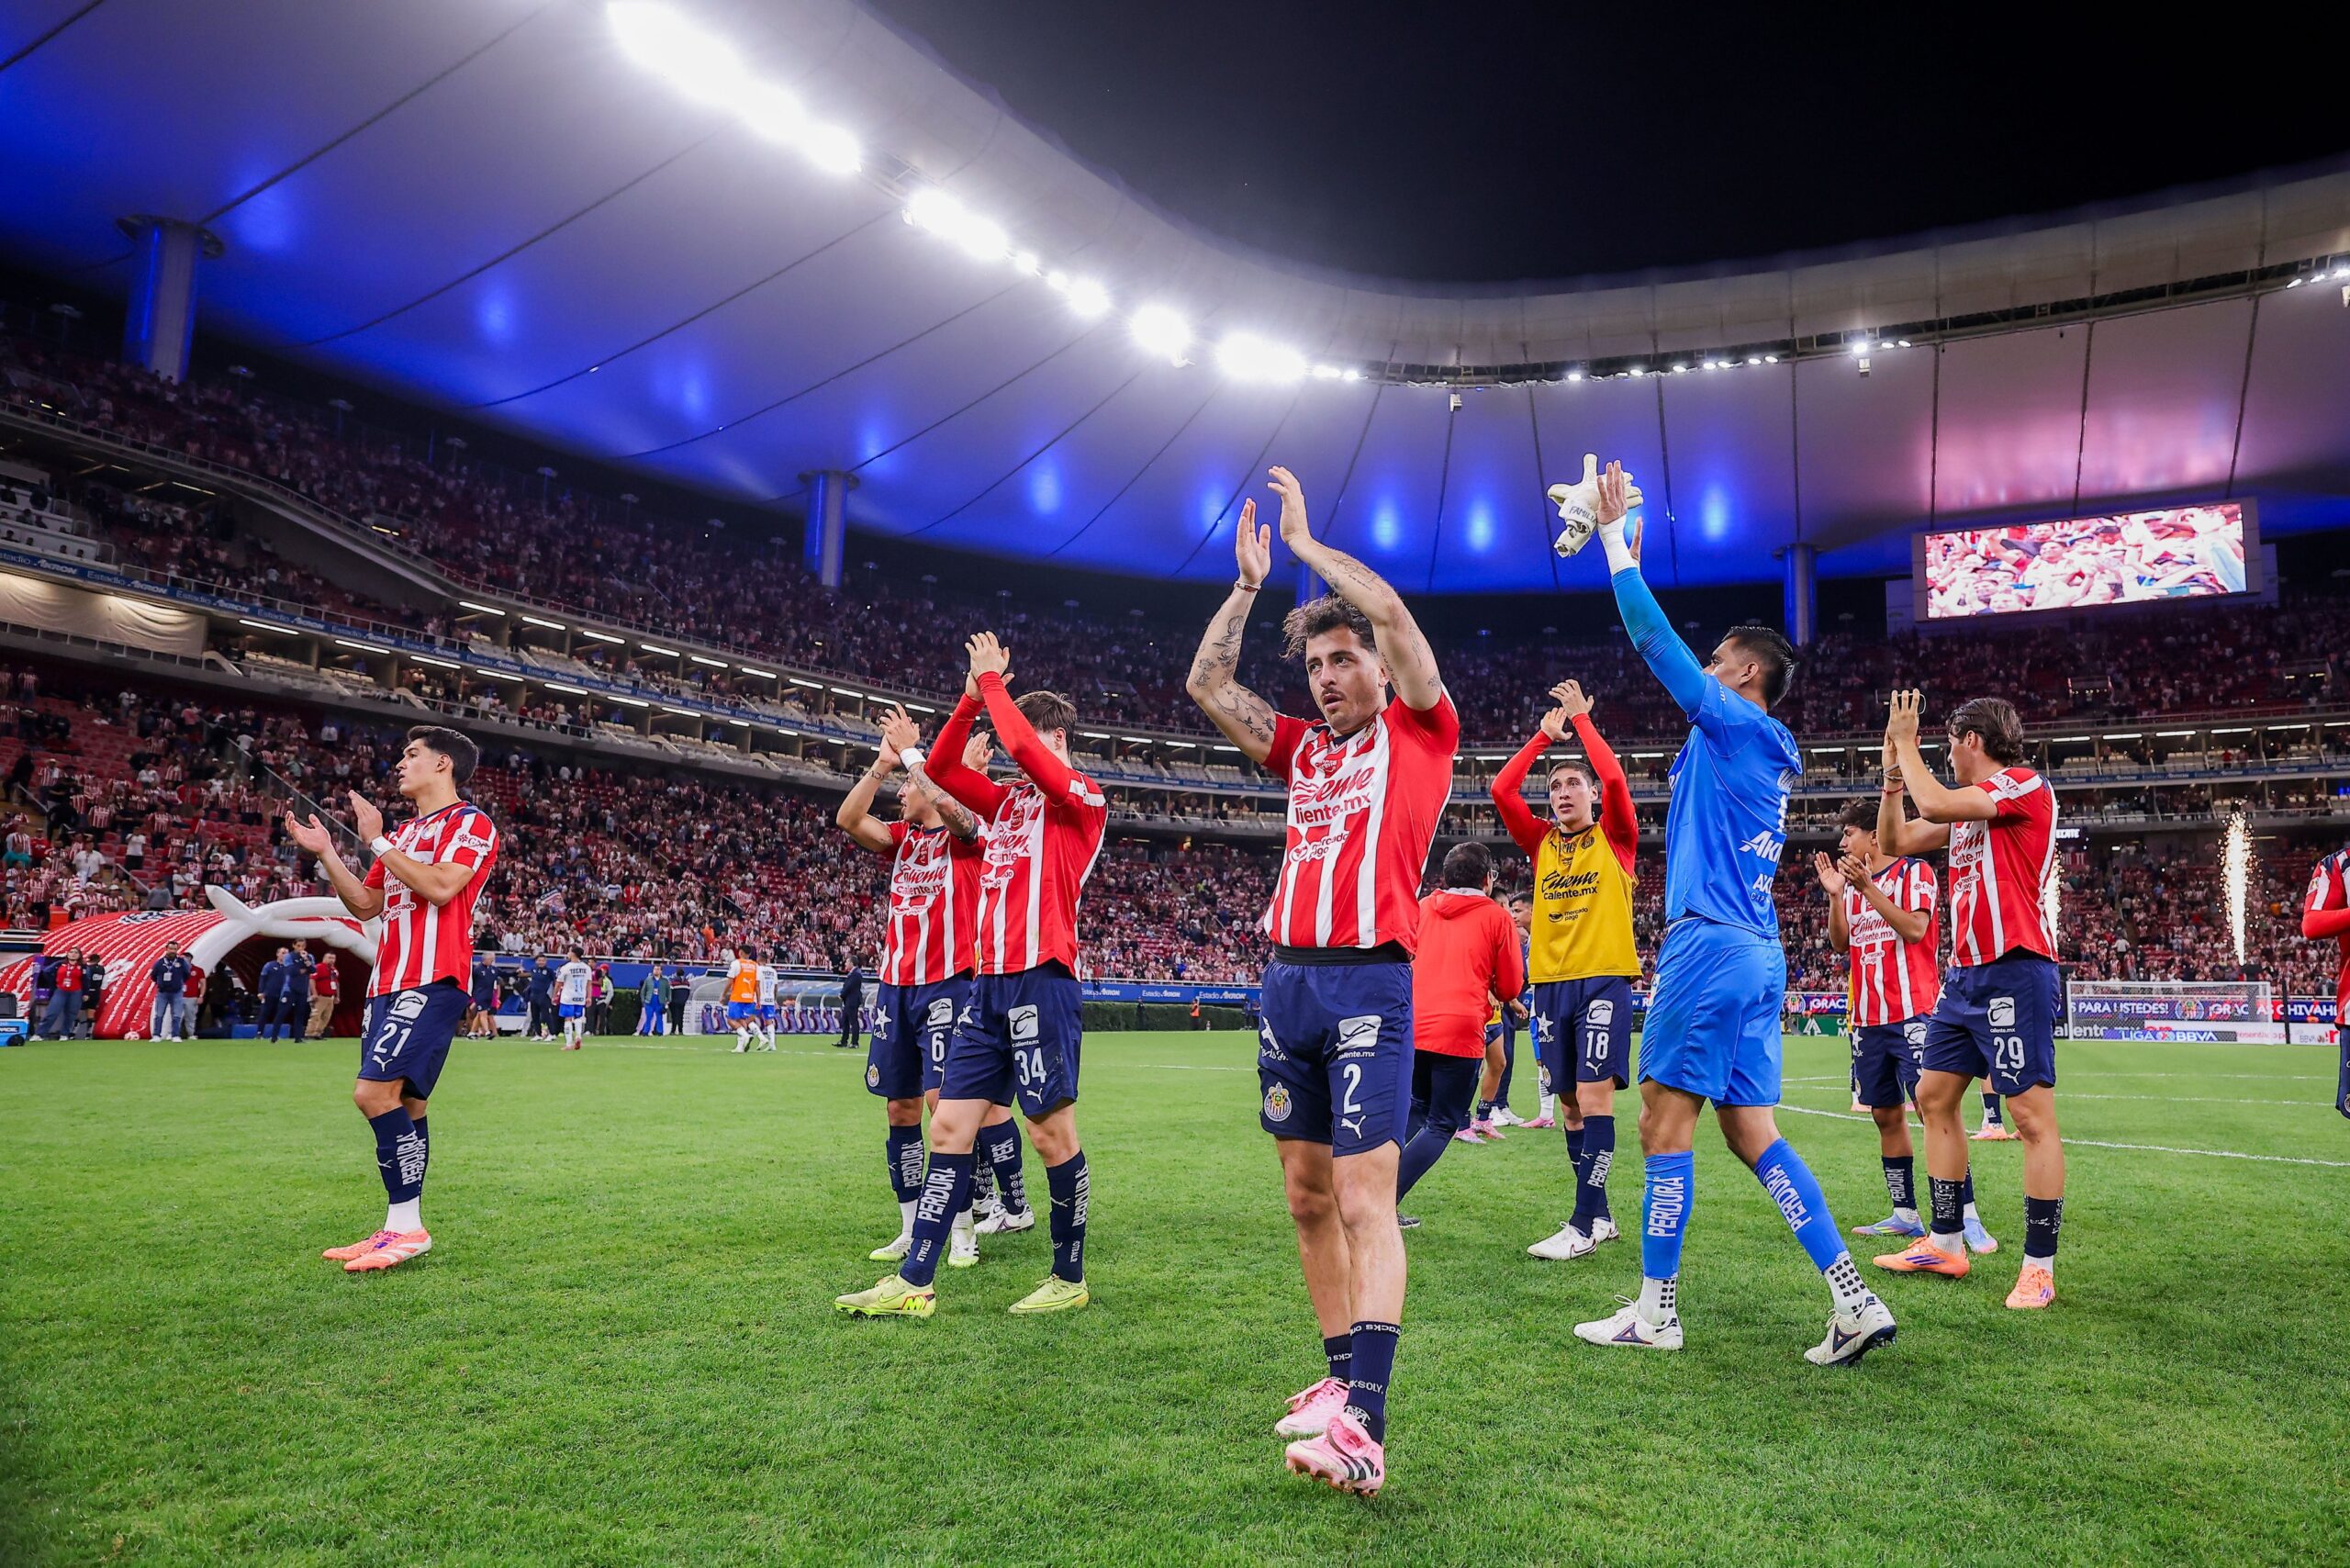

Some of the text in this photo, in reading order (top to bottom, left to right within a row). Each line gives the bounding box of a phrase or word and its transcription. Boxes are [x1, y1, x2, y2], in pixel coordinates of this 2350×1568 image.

[0, 551, 30, 566] stadio
[2079, 1002, 2169, 1014] PARA USTEDES!
[374, 1023, 411, 1057] 21
[932, 1032, 945, 1062] 6
[1586, 1030, 1609, 1060] 18
[1994, 1036, 2025, 1070] 29
[2121, 1031, 2218, 1041] LIGA BBVA
[1014, 1047, 1046, 1086] 34
[1343, 1063, 1361, 1114] 2
[397, 1130, 419, 1185] PERDURA
[901, 1139, 923, 1188] PERDURA
[1587, 1149, 1615, 1188] PERDURA
[1647, 1176, 1684, 1238] PERDURA
[1763, 1164, 1812, 1233] PERDURA
